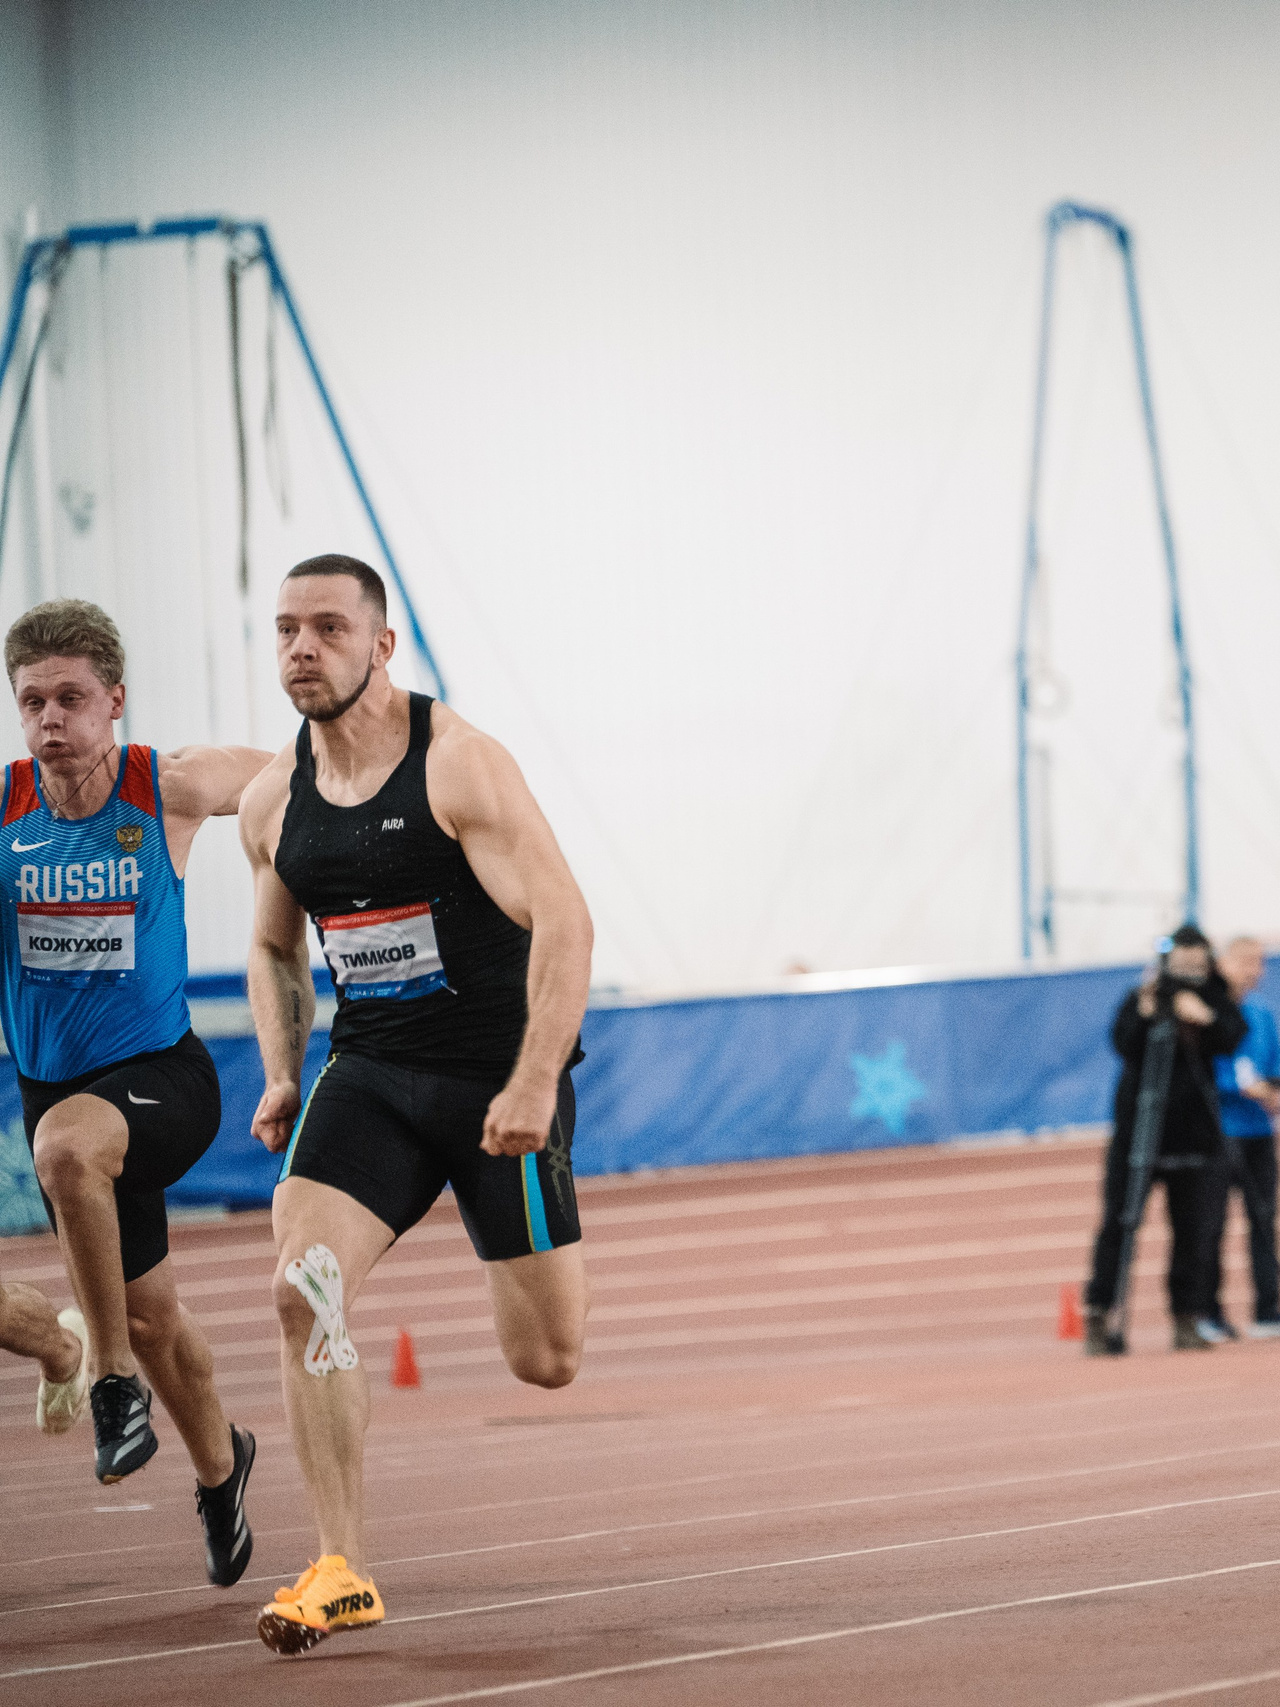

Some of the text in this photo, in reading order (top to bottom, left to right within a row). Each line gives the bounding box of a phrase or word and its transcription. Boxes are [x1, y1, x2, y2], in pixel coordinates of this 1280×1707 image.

[382, 817, 404, 831] AURA
[15, 857, 143, 903] RUSSIA
[29, 936, 122, 952] КОЖУХОВ
[339, 943, 416, 969] ТИМКОВ
[321, 1591, 374, 1622] NITRO
